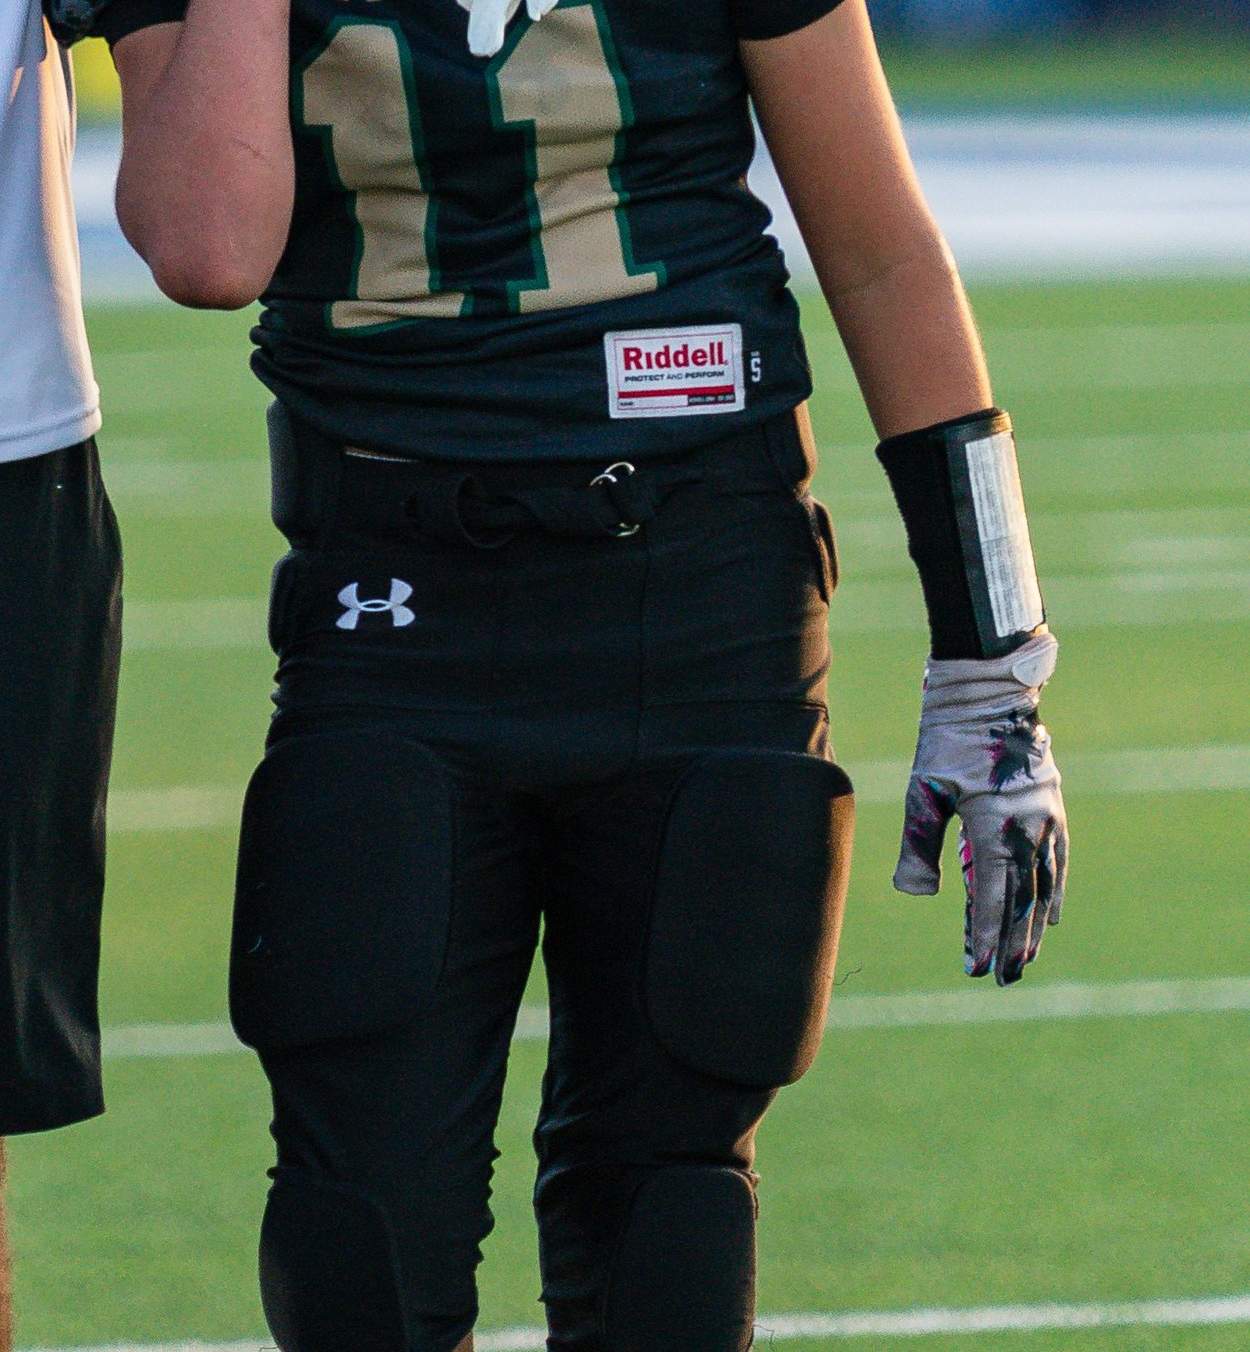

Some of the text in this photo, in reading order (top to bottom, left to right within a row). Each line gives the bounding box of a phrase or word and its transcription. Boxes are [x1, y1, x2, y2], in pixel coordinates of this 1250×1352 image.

[622, 341, 725, 371] Riddell
[624, 373, 665, 383] PROTECT
[684, 370, 726, 379] PERFORM
